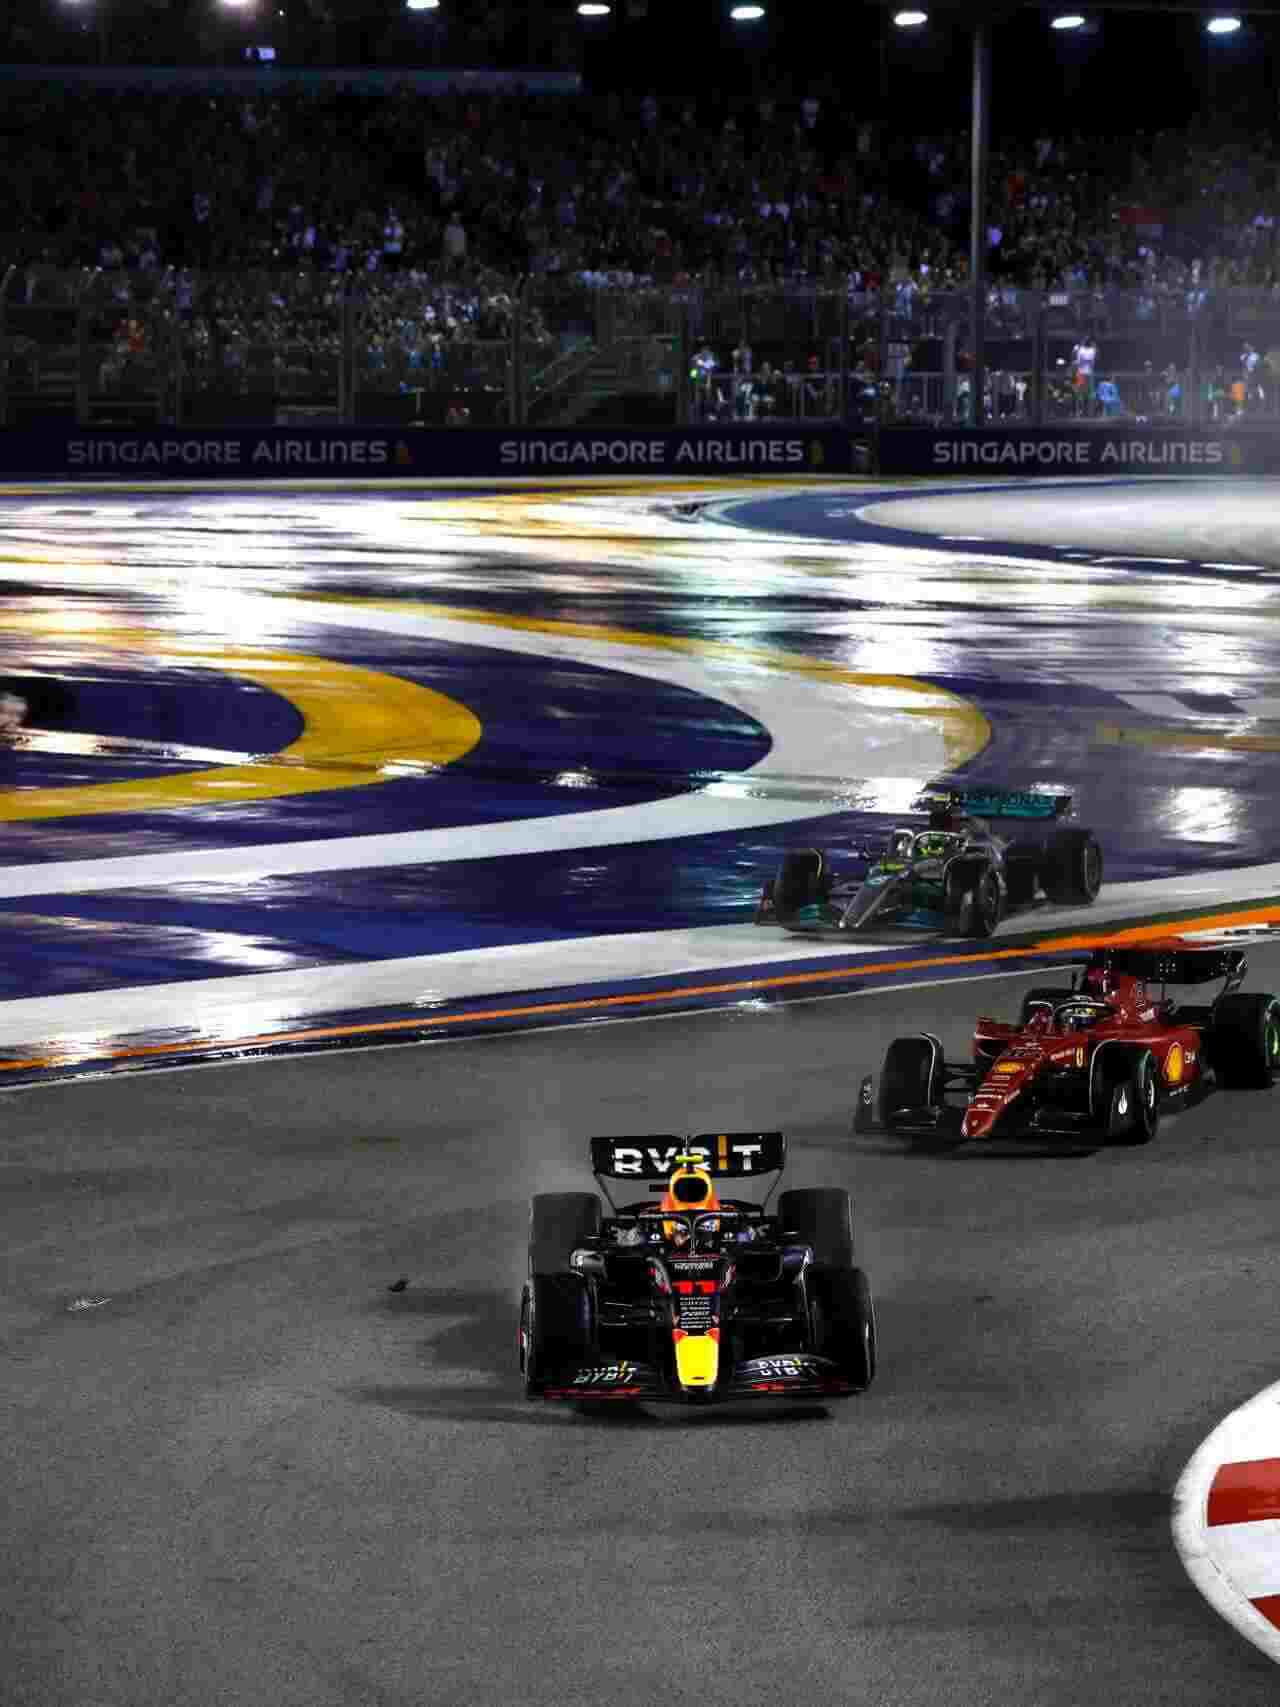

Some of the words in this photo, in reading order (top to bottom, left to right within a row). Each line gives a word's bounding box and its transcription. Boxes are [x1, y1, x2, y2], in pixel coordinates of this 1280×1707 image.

[67, 440, 240, 464] SINGAPORE
[252, 440, 388, 464] AIRLINES
[500, 440, 665, 464] SINGAPORE
[675, 440, 804, 463] AIRLINES
[933, 441, 1090, 464] SINGAPORE
[1100, 441, 1223, 464] AIRLINES
